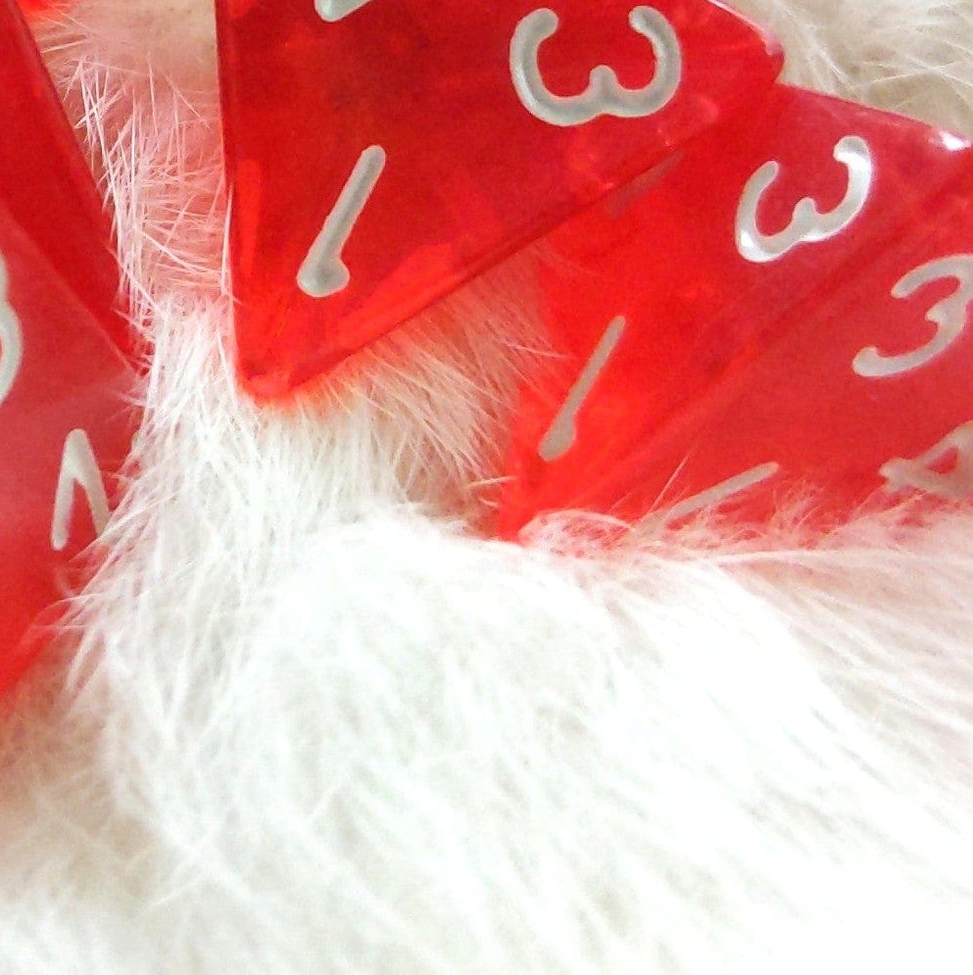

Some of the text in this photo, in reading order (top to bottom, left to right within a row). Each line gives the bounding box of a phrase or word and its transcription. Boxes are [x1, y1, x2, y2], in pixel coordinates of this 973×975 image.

[510, 5, 683, 128] 3
[297, 145, 387, 298] 1
[735, 136, 872, 263] 3
[853, 254, 973, 377] 3
[539, 315, 627, 462] 1
